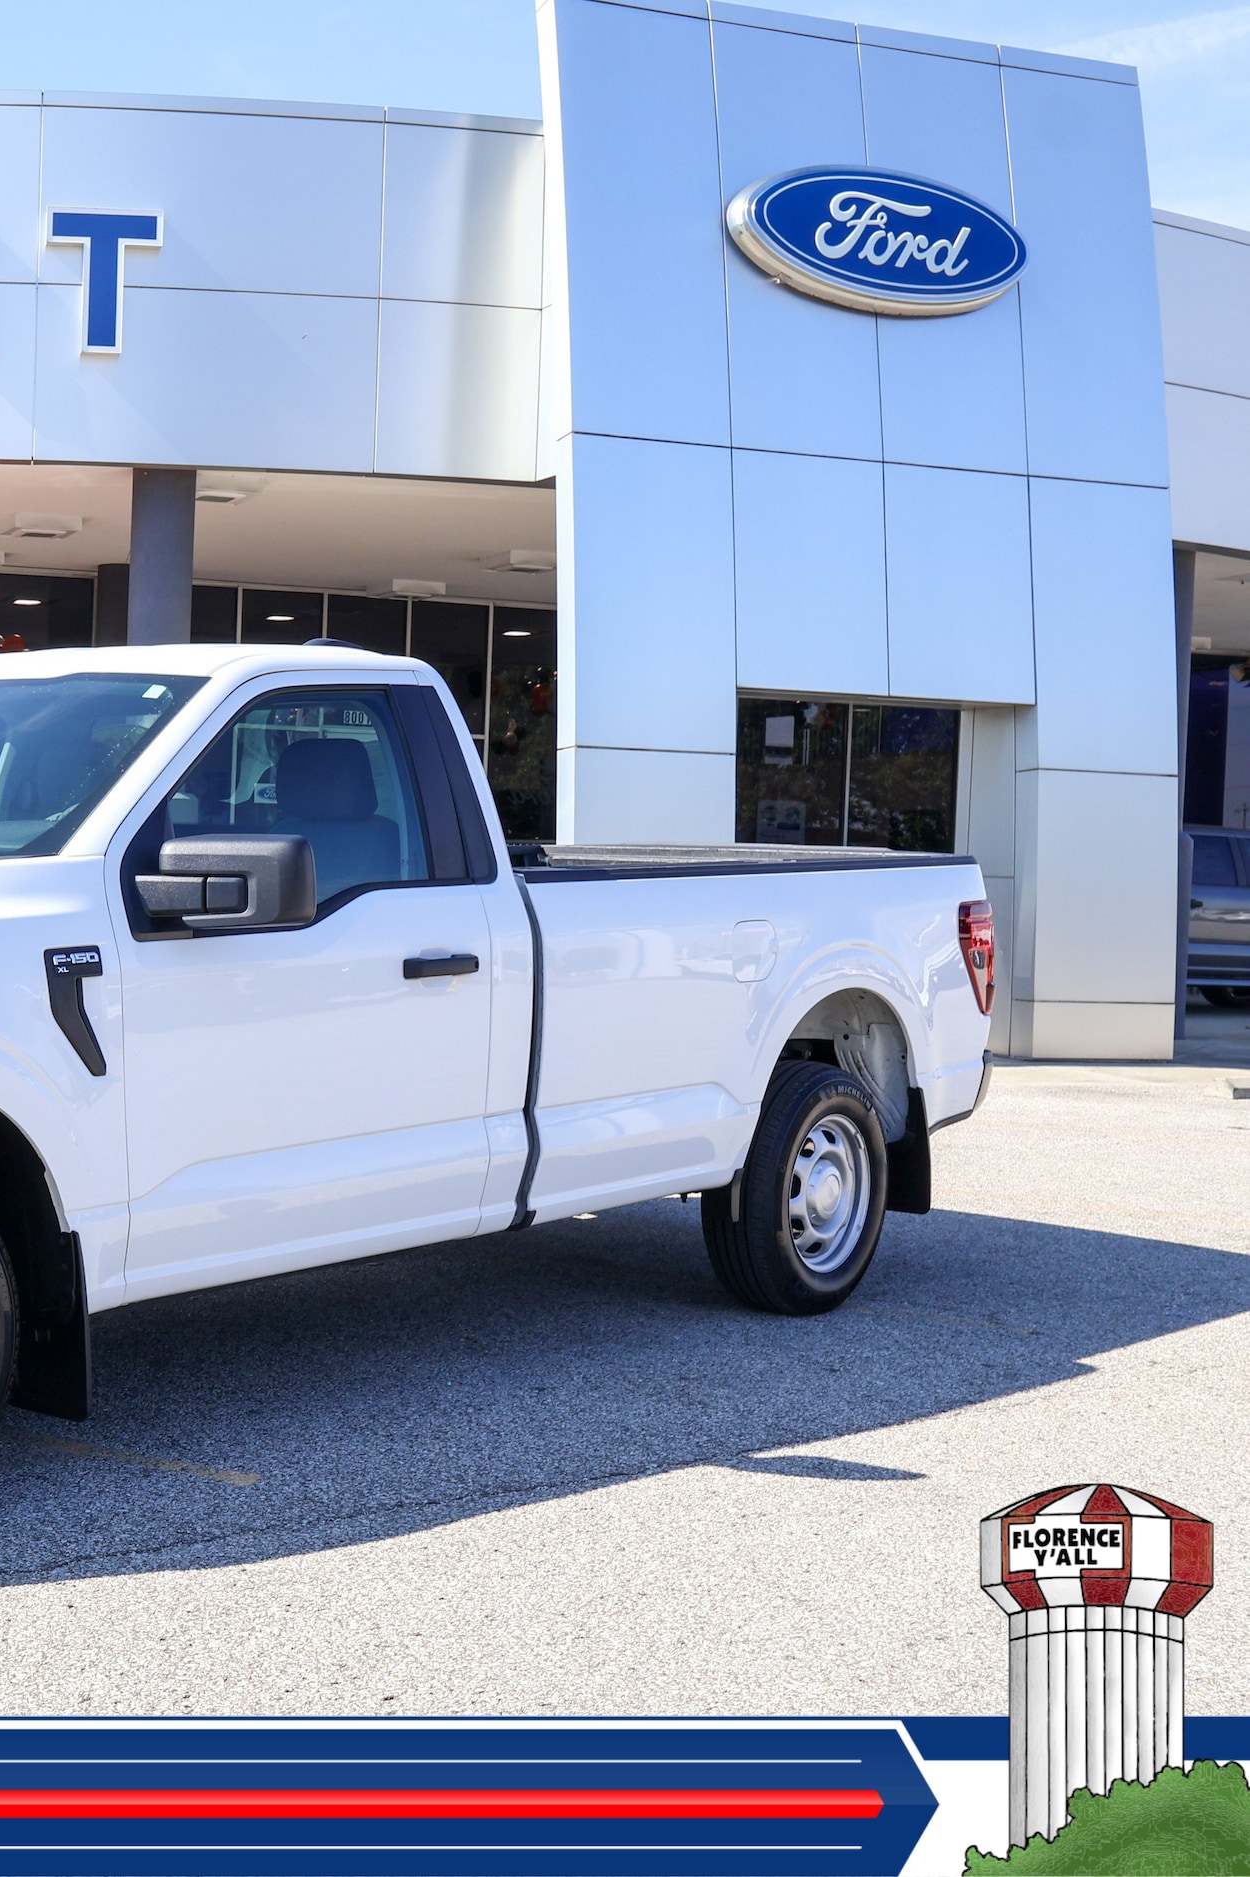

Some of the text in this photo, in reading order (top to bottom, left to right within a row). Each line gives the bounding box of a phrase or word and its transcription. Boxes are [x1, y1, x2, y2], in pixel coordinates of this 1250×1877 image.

[814, 190, 972, 277] Ford
[53, 951, 100, 966] F-150
[837, 1085, 872, 1111] MICHELIN
